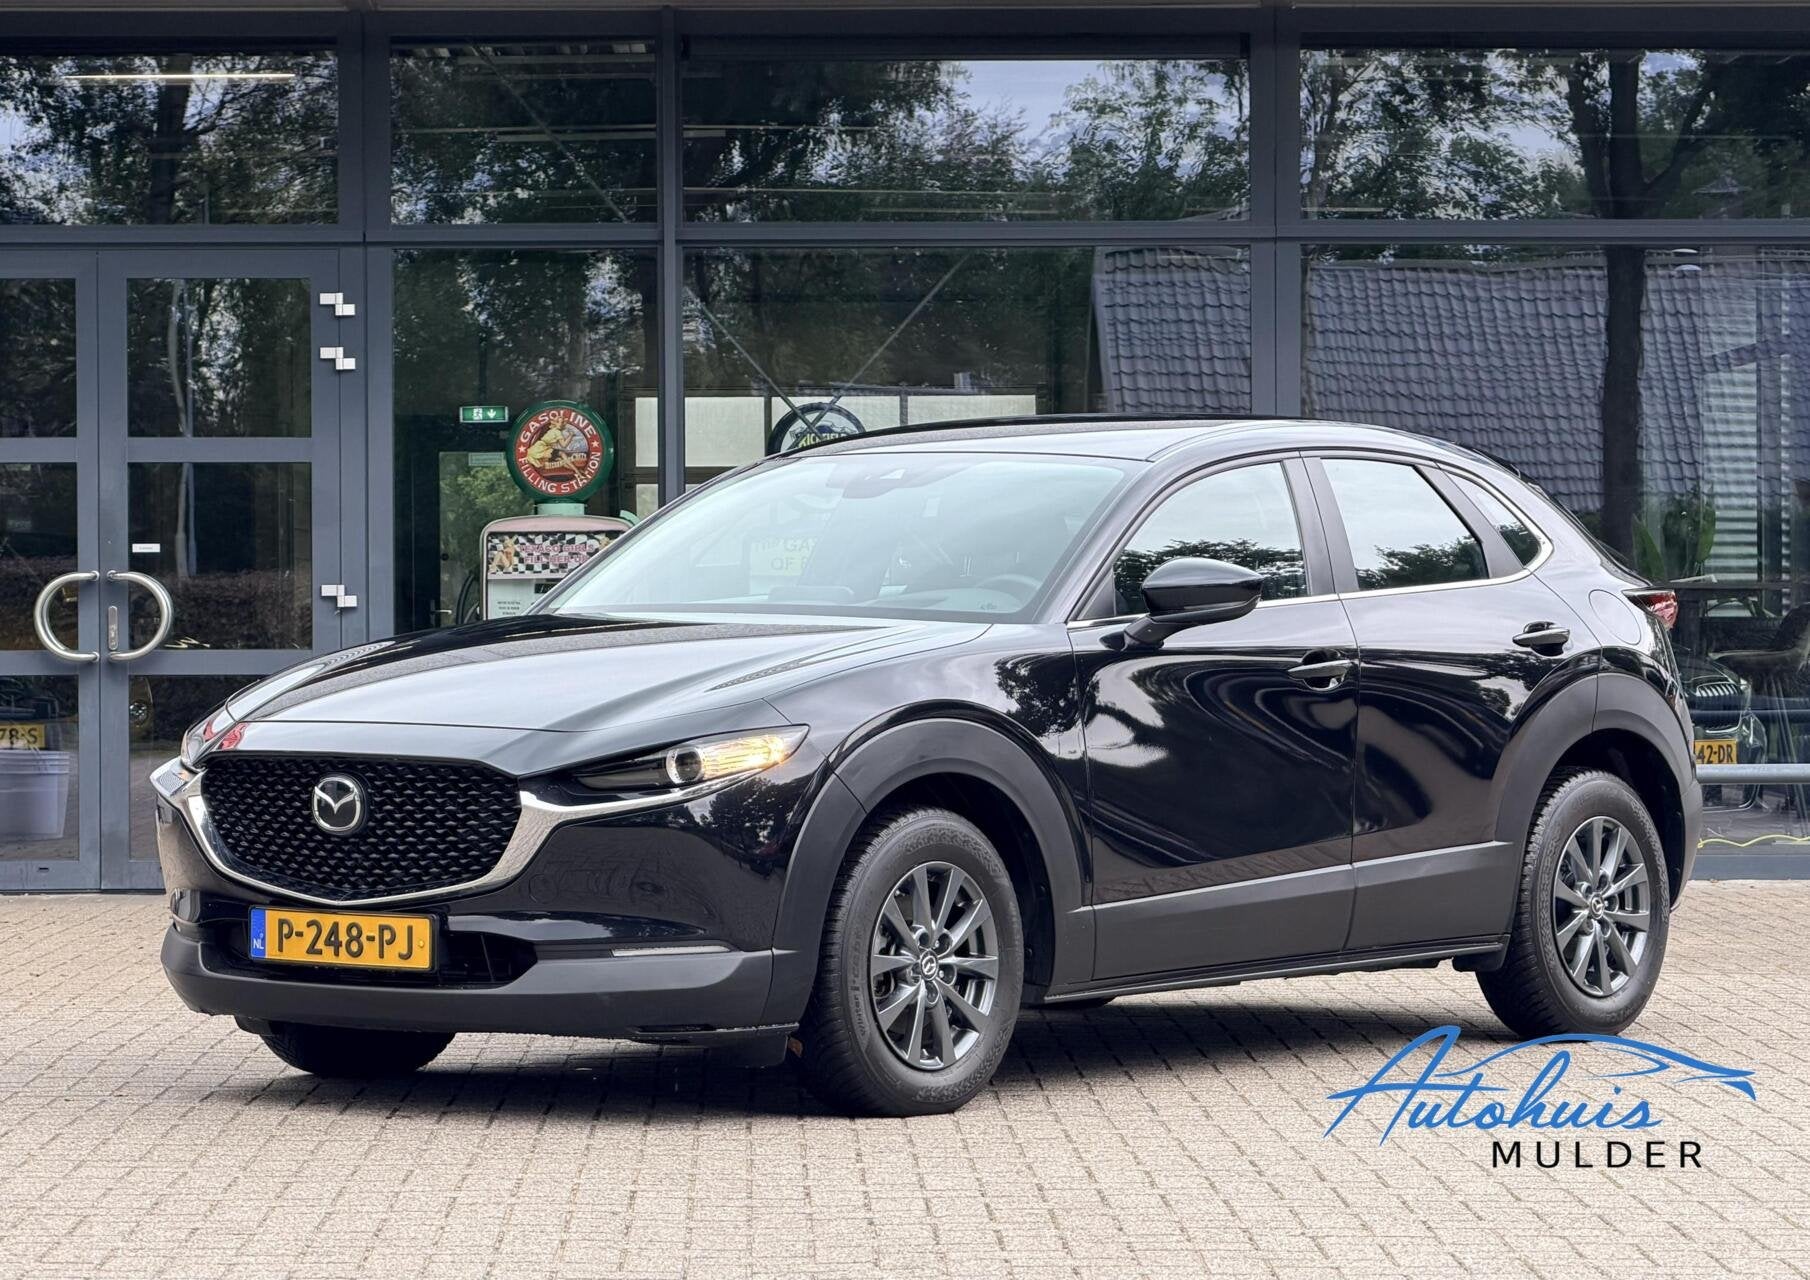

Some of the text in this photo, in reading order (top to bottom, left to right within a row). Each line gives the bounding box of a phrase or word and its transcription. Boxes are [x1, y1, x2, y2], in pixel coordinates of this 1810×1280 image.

[519, 451, 601, 493] FILLING STATION
[253, 918, 413, 961] NL P-248-PJ
